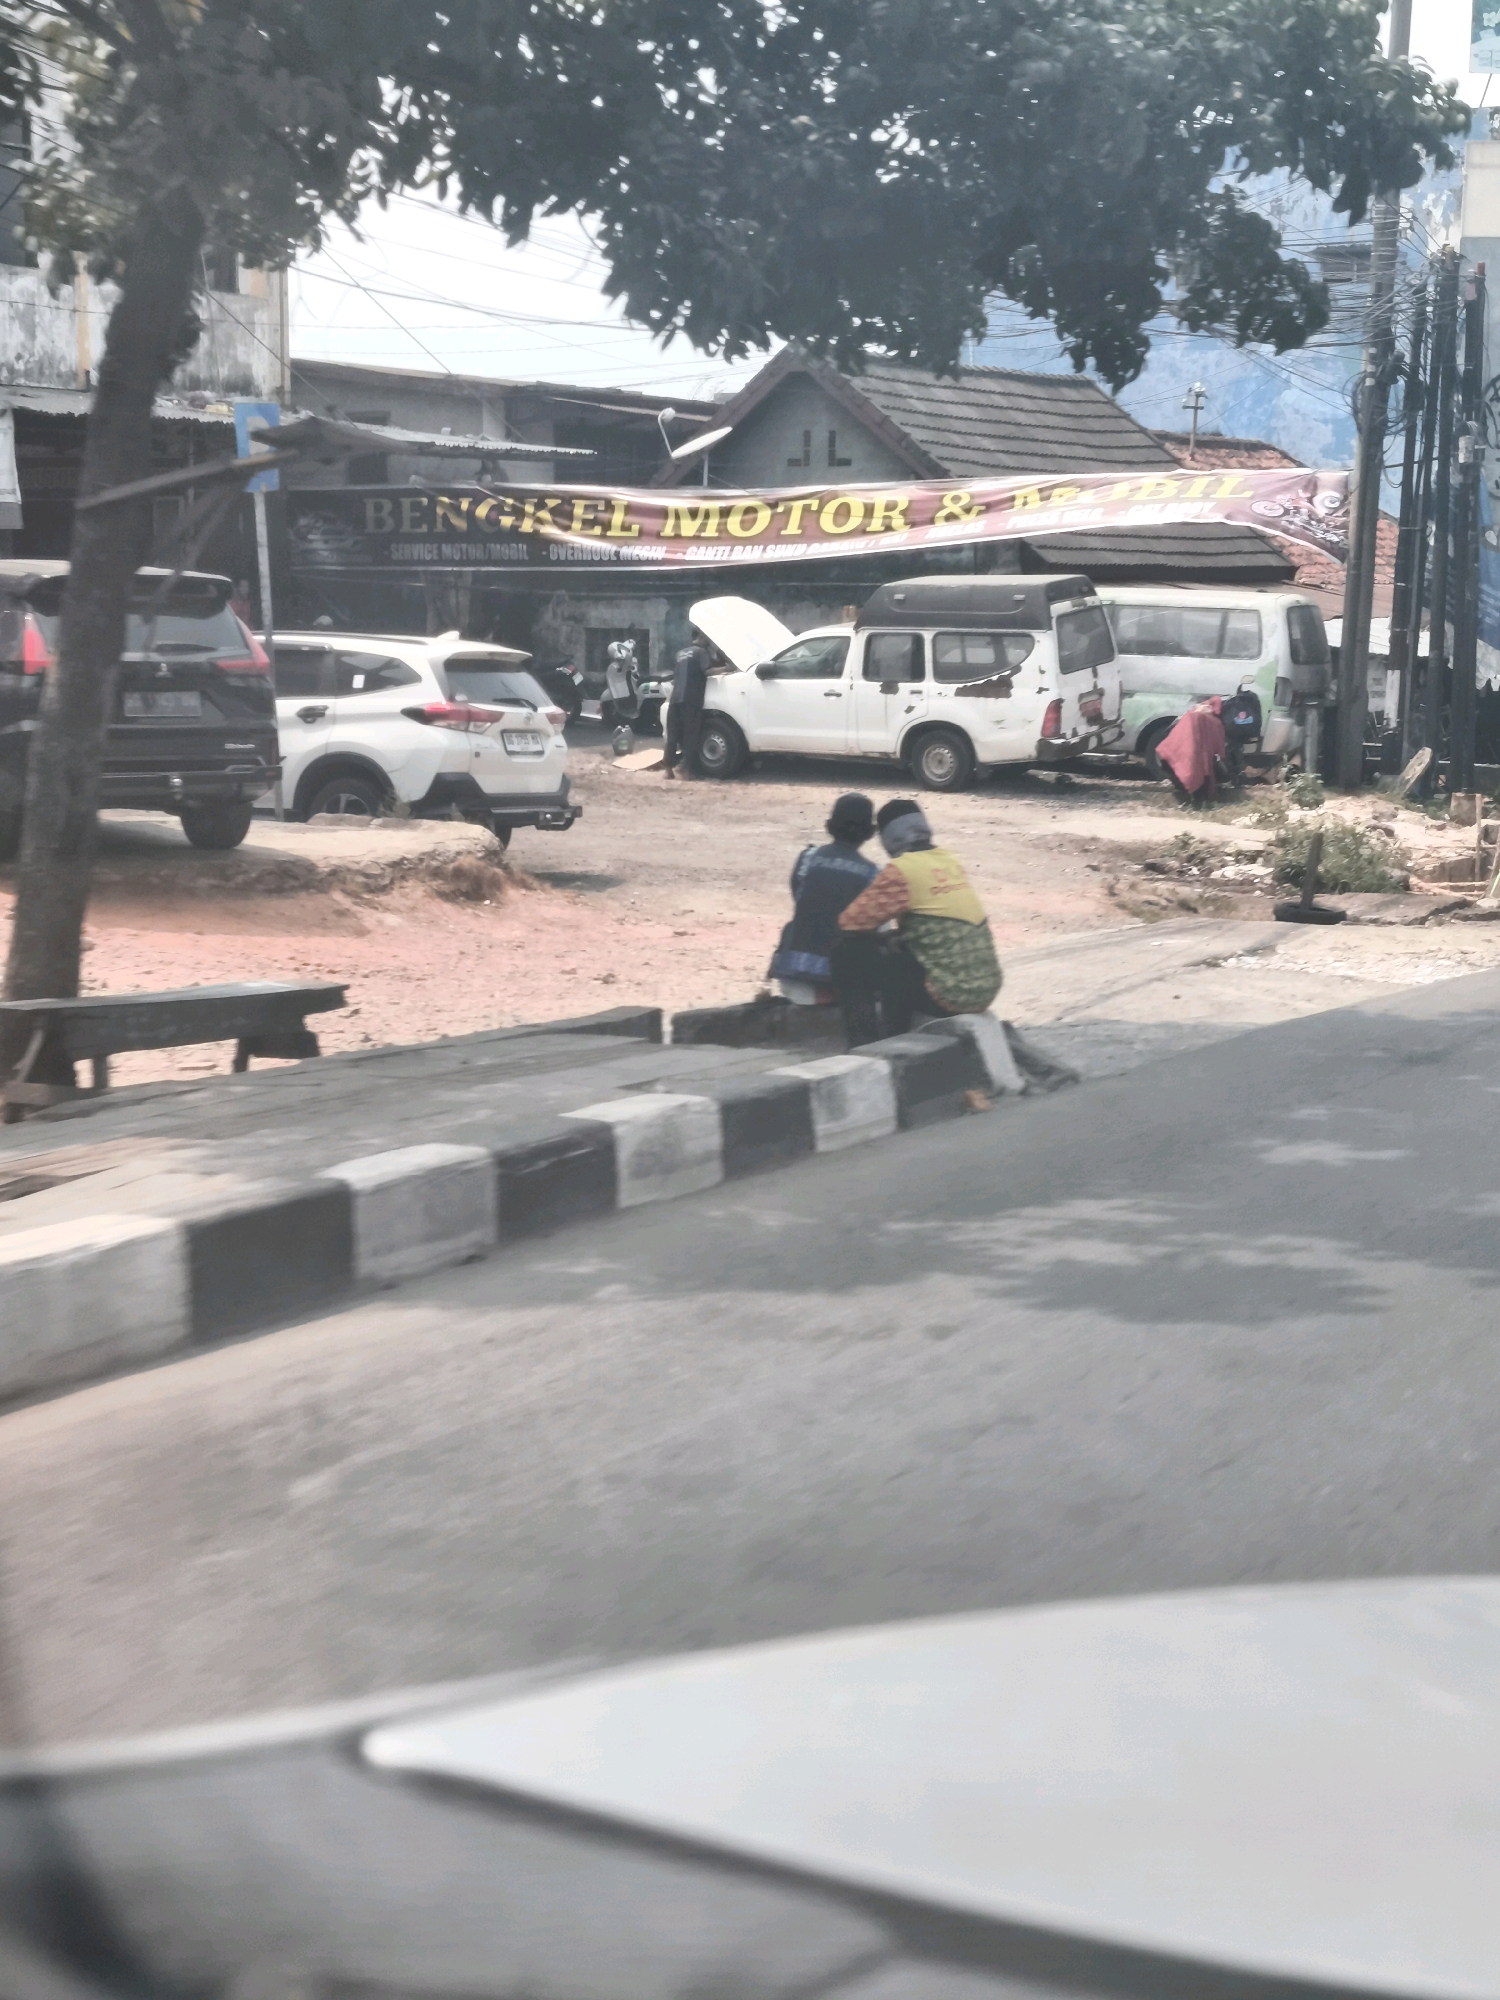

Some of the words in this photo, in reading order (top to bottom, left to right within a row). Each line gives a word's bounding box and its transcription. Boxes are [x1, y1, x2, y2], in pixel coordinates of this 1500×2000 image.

[363, 497, 639, 536] BENGKEL
[660, 496, 912, 537] MOTOR
[934, 492, 985, 526] &
[391, 543, 438, 561] SERVICE
[684, 545, 732, 560] GANTI
[731, 544, 764, 560] BAN
[763, 542, 808, 559] SUKU
[1006, 510, 1061, 530] PRESS
[1062, 508, 1105, 524] VELG
